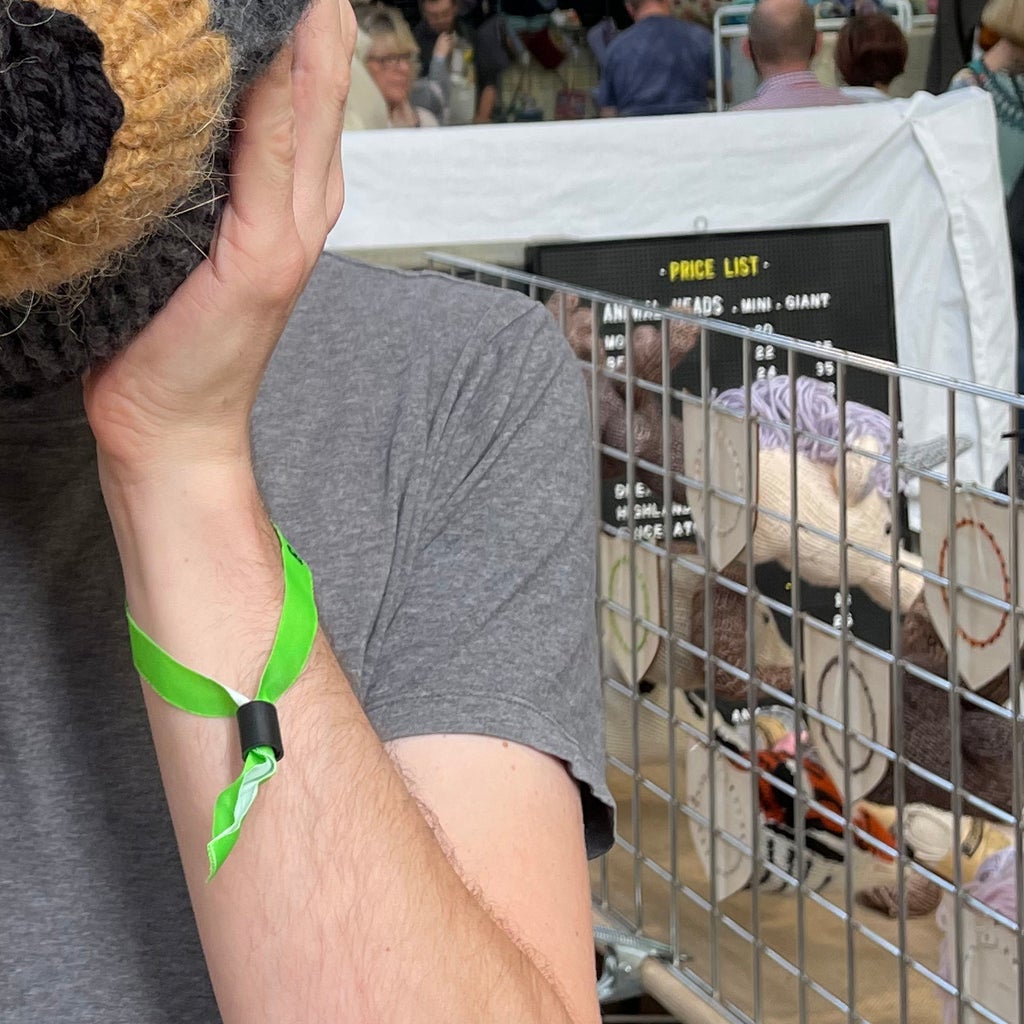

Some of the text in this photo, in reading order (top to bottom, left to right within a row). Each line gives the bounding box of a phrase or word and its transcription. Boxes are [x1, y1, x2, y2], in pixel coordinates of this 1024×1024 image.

[669, 255, 760, 282] PRICE LIST
[740, 296, 773, 314] MINI
[785, 292, 832, 311] GIANT
[755, 344, 776, 361] 22
